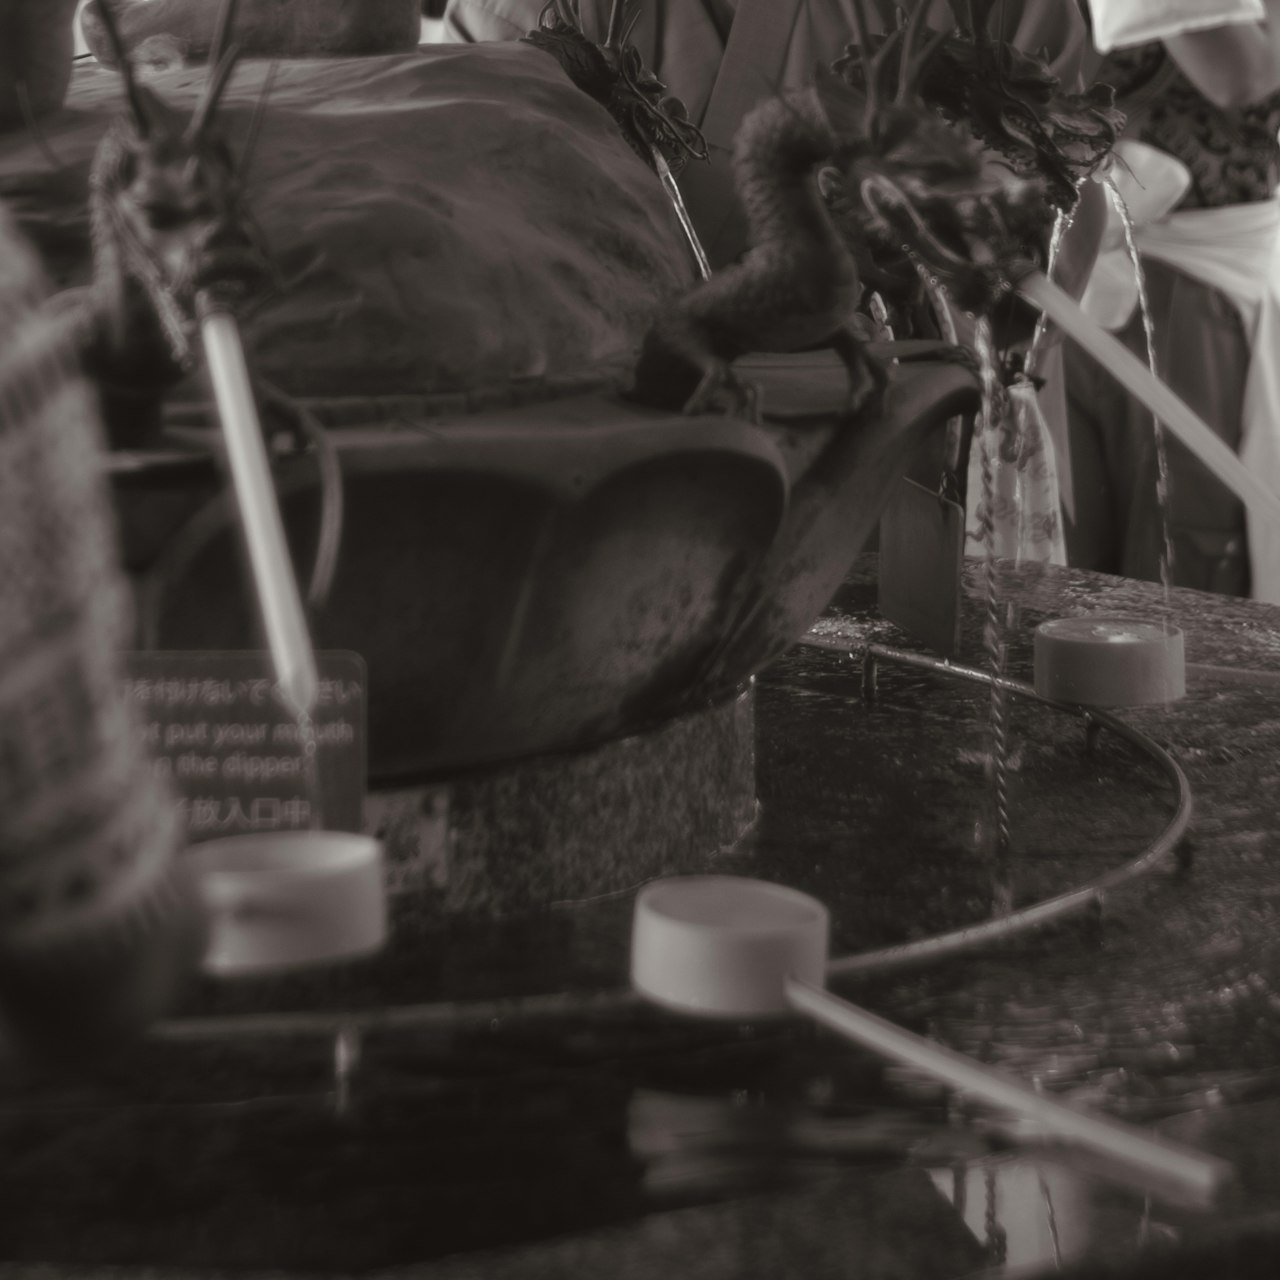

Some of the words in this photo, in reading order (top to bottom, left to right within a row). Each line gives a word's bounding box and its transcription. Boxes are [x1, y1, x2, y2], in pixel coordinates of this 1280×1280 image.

[165, 721, 208, 748] put
[212, 722, 268, 749] your
[176, 751, 219, 776] the
